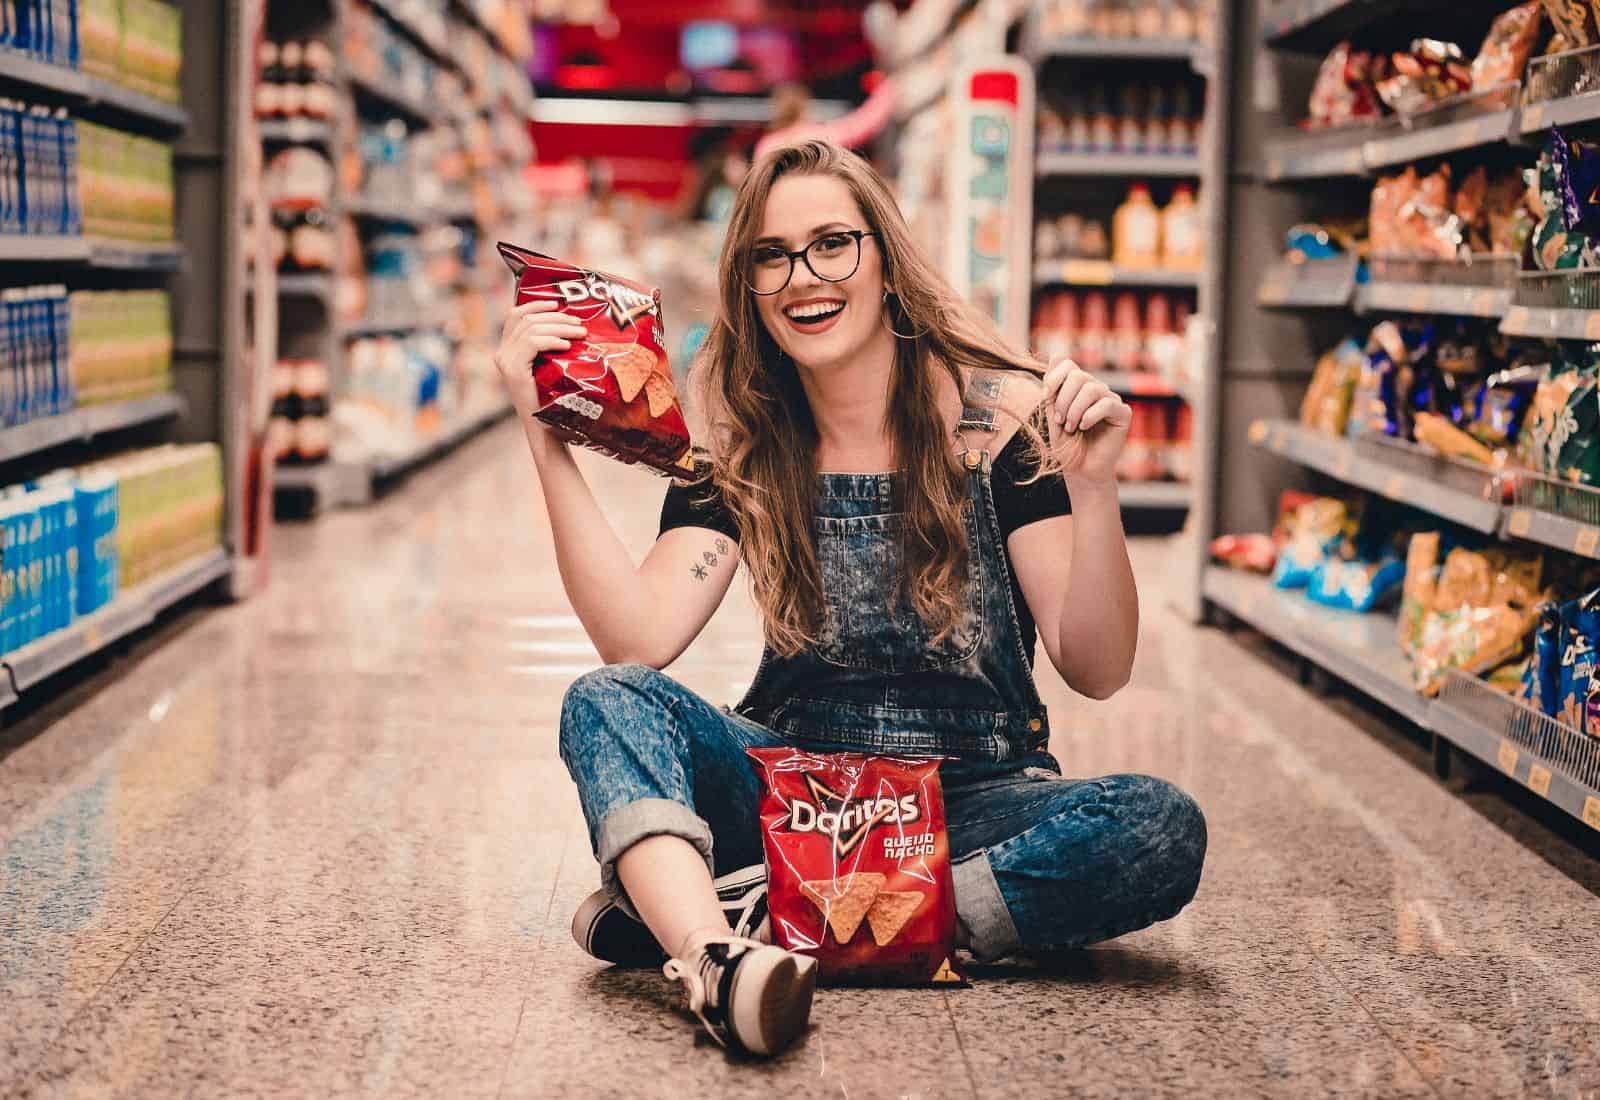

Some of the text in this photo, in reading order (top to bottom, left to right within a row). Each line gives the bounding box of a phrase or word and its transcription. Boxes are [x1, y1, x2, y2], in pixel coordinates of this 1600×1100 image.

[790, 794, 920, 833] Doritos
[883, 832, 935, 848] QUEIJO
[884, 845, 936, 859] NACHO
